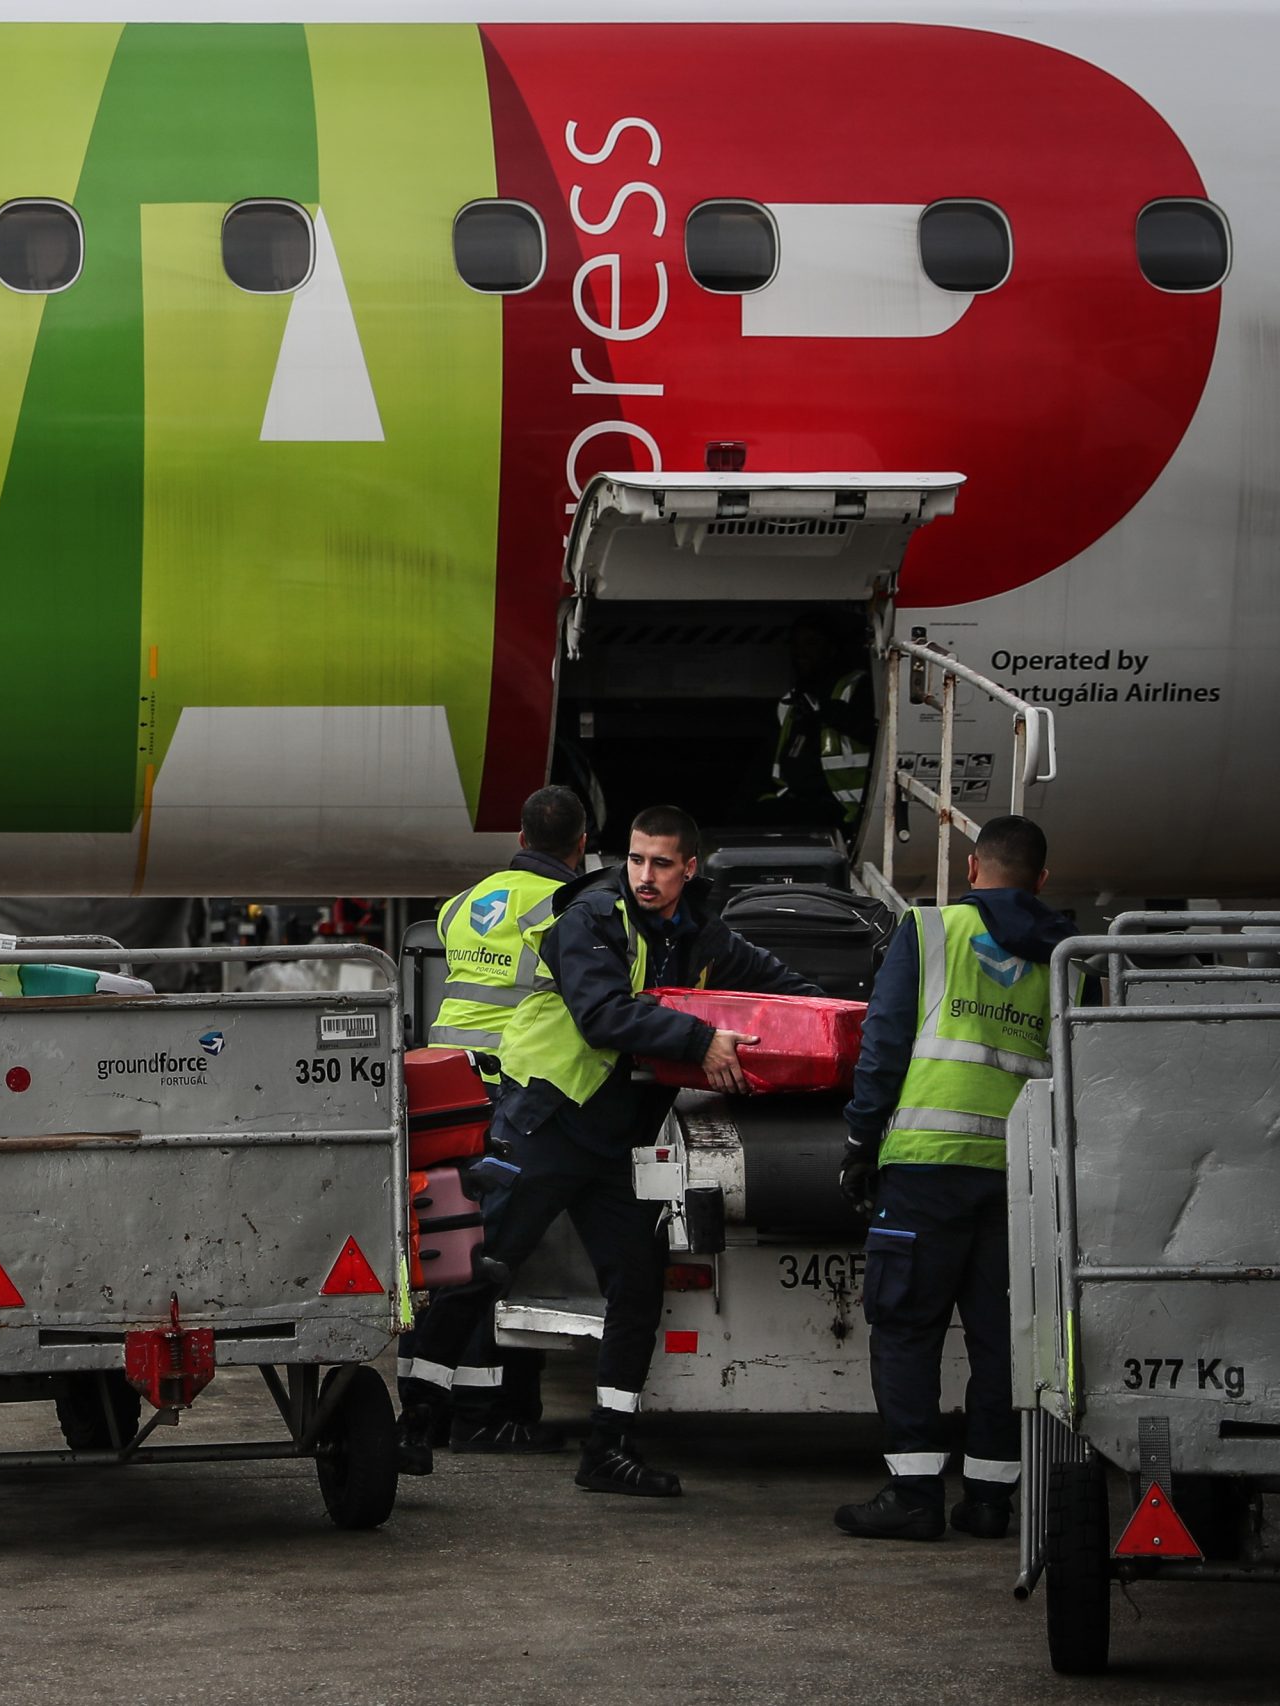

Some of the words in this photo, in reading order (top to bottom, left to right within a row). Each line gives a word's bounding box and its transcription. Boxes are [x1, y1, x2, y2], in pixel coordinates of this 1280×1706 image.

[991, 650, 1110, 675] Operated
[1117, 650, 1149, 675] by
[1125, 683, 1221, 702] Airlines
[448, 946, 512, 967] groundforce
[475, 965, 509, 976] PORTUGAL
[950, 998, 1044, 1031] groundforce
[97, 1052, 208, 1080] groundforce
[295, 1058, 341, 1085] 350
[350, 1056, 387, 1088] Kg
[160, 1076, 208, 1086] PORTUGAL
[1123, 1358, 1184, 1390] 377
[1197, 1358, 1246, 1398] Kg
